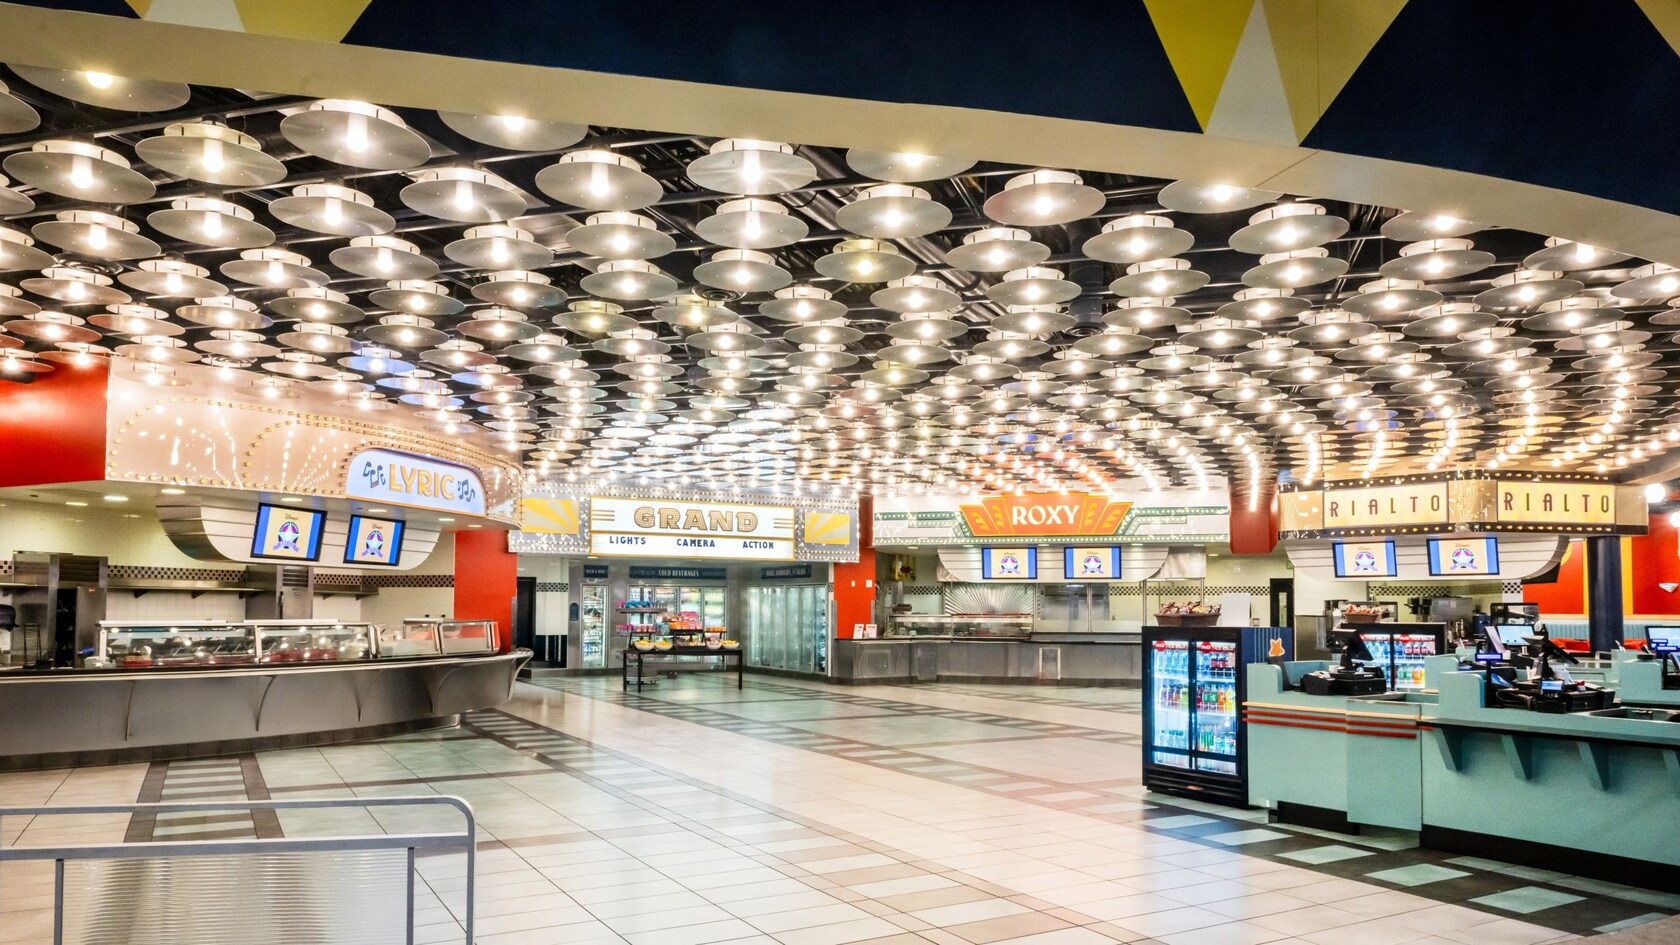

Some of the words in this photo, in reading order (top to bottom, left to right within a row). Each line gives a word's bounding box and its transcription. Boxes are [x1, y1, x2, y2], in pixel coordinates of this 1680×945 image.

[389, 463, 455, 501] LYRIC
[1330, 495, 1440, 517] RIALTO
[1503, 492, 1609, 513] RIALTO
[633, 506, 759, 533] GRAND
[1012, 504, 1080, 526] ROXY
[609, 535, 647, 545] LIGHTS
[676, 538, 716, 548] CAMERA
[742, 540, 774, 550] ACTION
